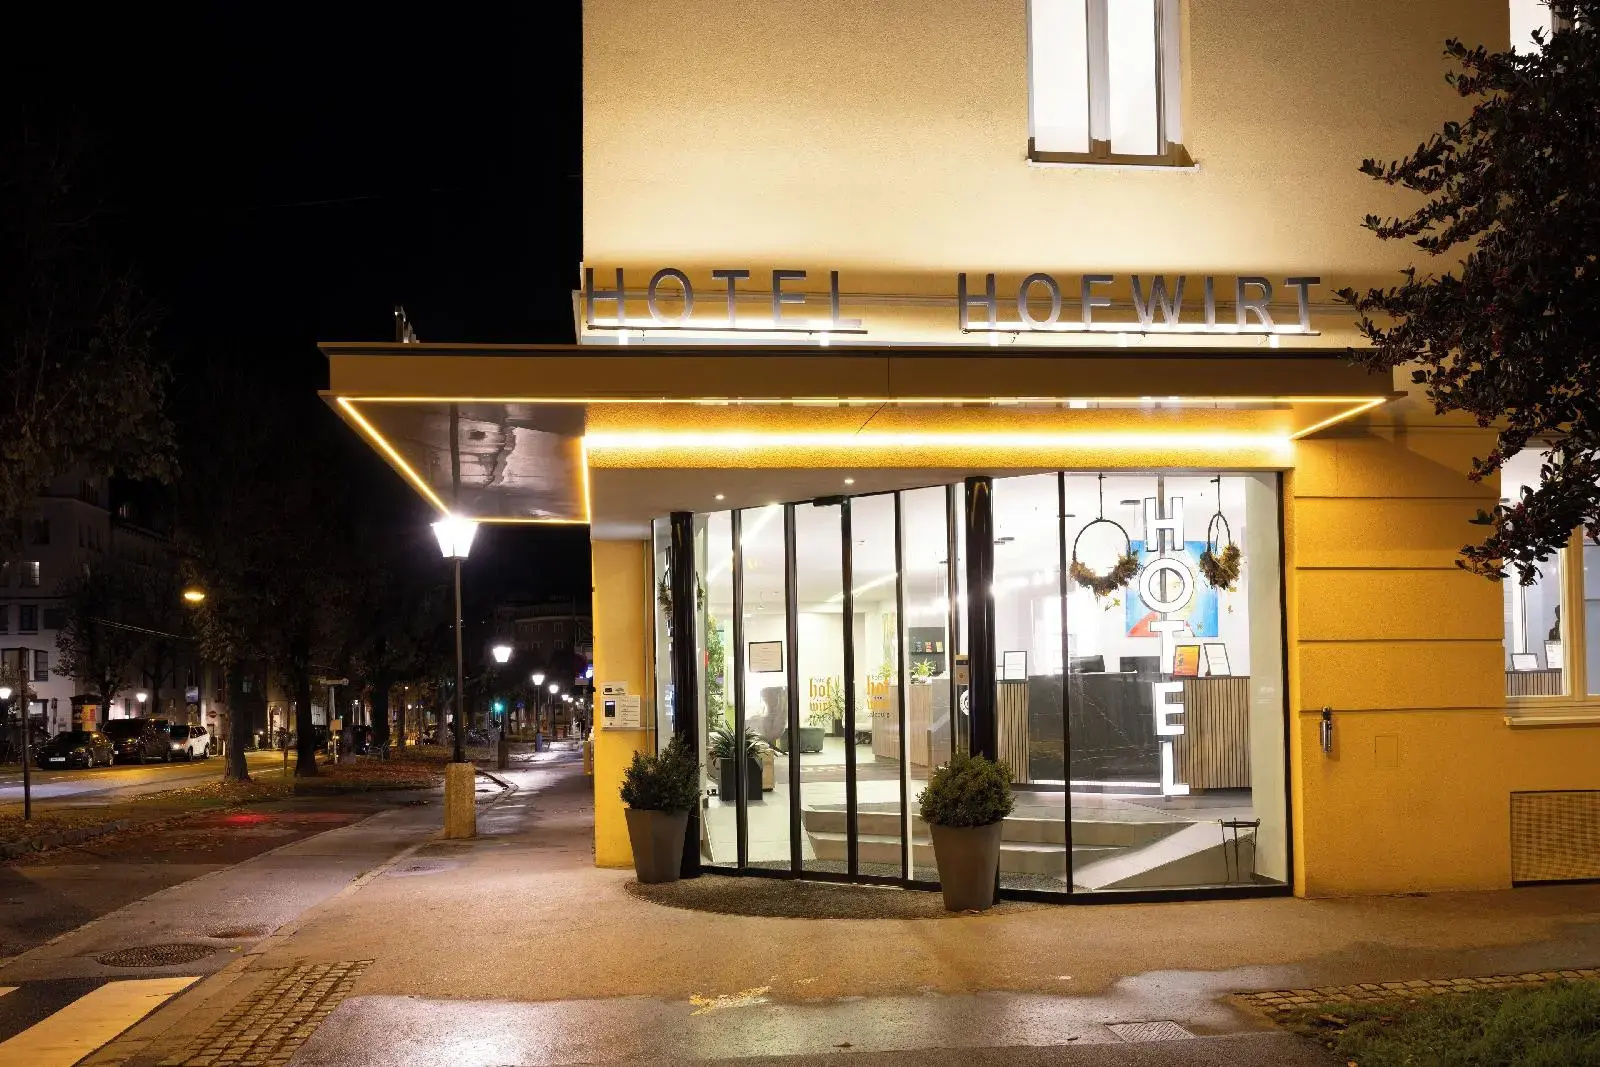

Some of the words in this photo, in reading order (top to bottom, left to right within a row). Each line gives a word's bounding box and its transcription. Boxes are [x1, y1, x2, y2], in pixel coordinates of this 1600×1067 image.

[586, 268, 863, 327] HOTEL
[958, 272, 1321, 332] HOFWIRT
[1139, 496, 1195, 796] HOTEL
